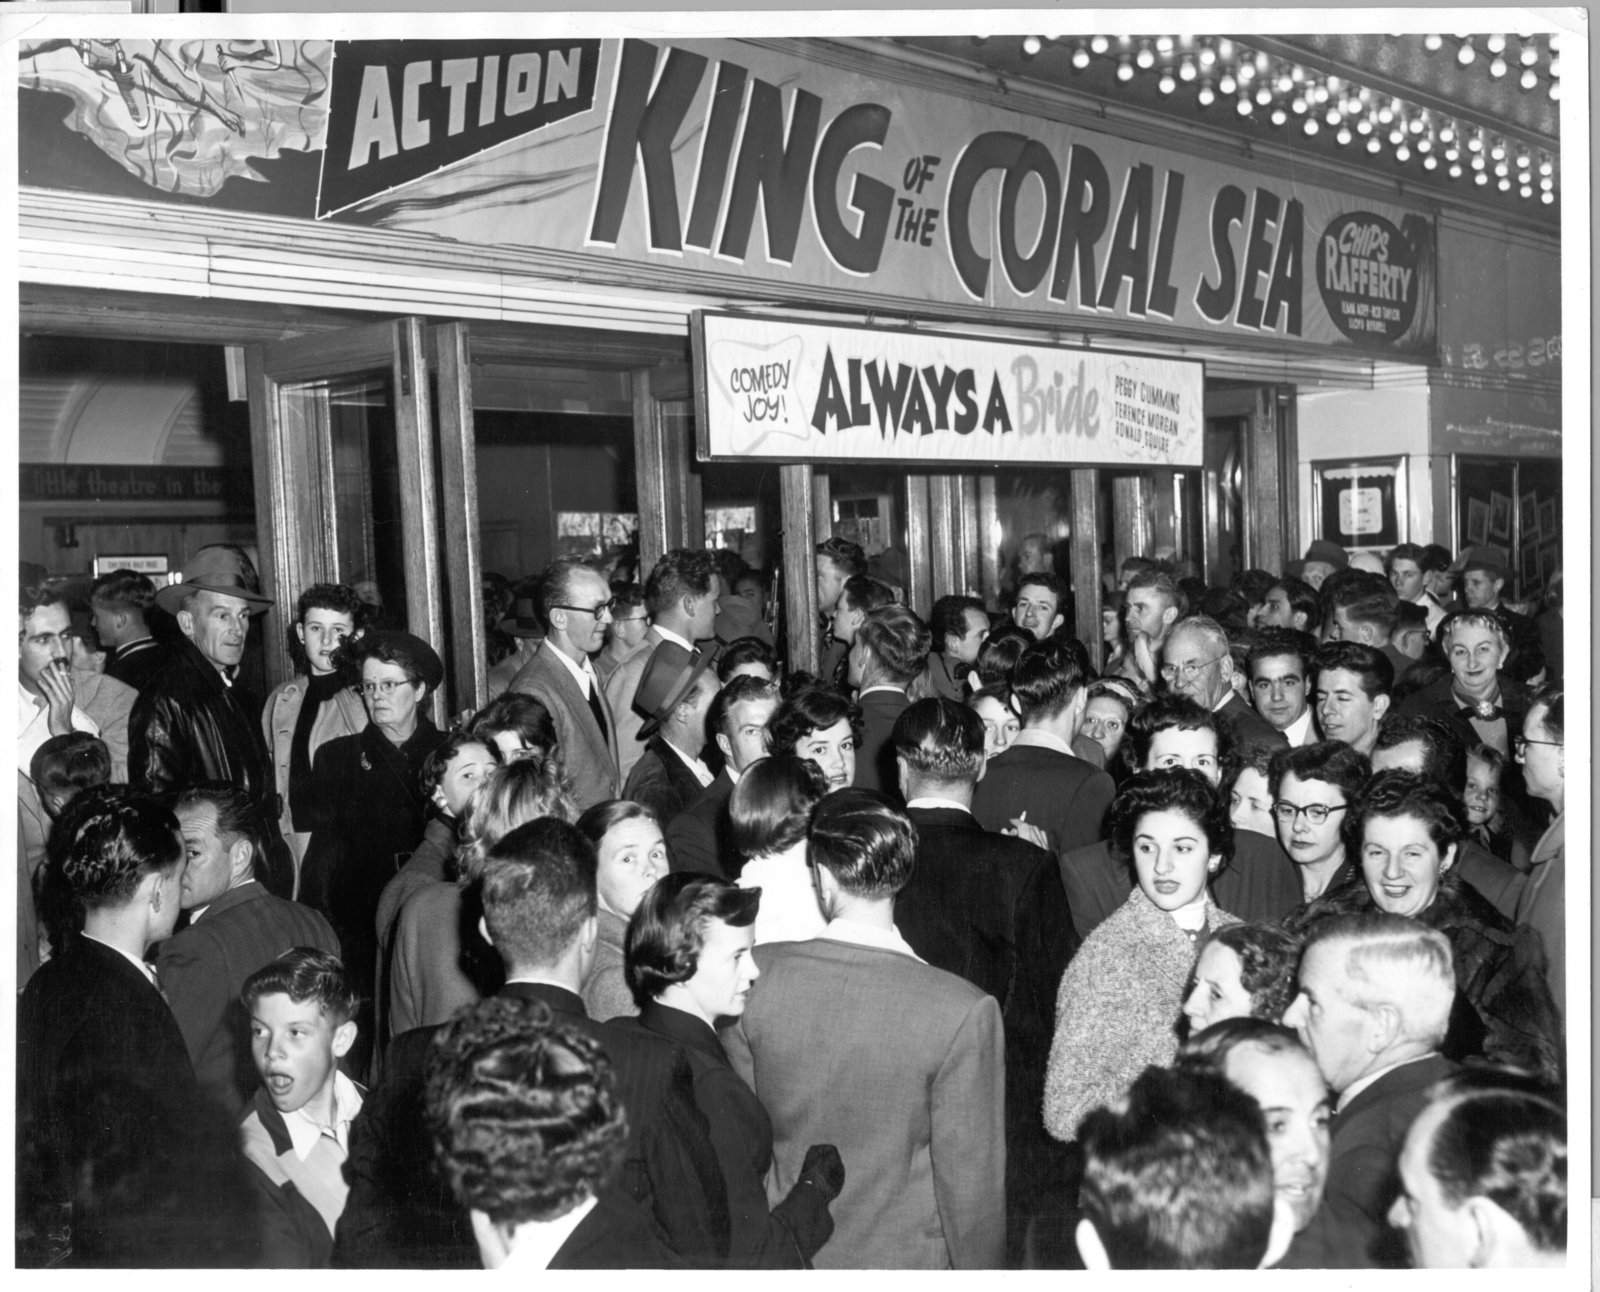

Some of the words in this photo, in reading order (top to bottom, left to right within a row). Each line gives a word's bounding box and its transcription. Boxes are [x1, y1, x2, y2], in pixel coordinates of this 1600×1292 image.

[348, 48, 582, 170] ACTION
[584, 38, 896, 277] KING
[903, 155, 941, 194] OF
[894, 198, 939, 247] THE
[944, 131, 1184, 320] CORAL
[1193, 185, 1304, 337] SEA
[1340, 222, 1390, 261] CHIPS
[1325, 235, 1412, 302] RAFFERTY
[730, 360, 791, 394] COMEDY
[811, 343, 979, 440] ALWAYS
[982, 369, 1013, 436] A
[1010, 355, 1100, 438] Bride
[1115, 375, 1138, 399] PEGGY
[1140, 382, 1180, 415] CUMMINS
[743, 395, 789, 423] JOY!
[1115, 401, 1145, 426] TERENCE
[1147, 411, 1178, 436] MORGAN
